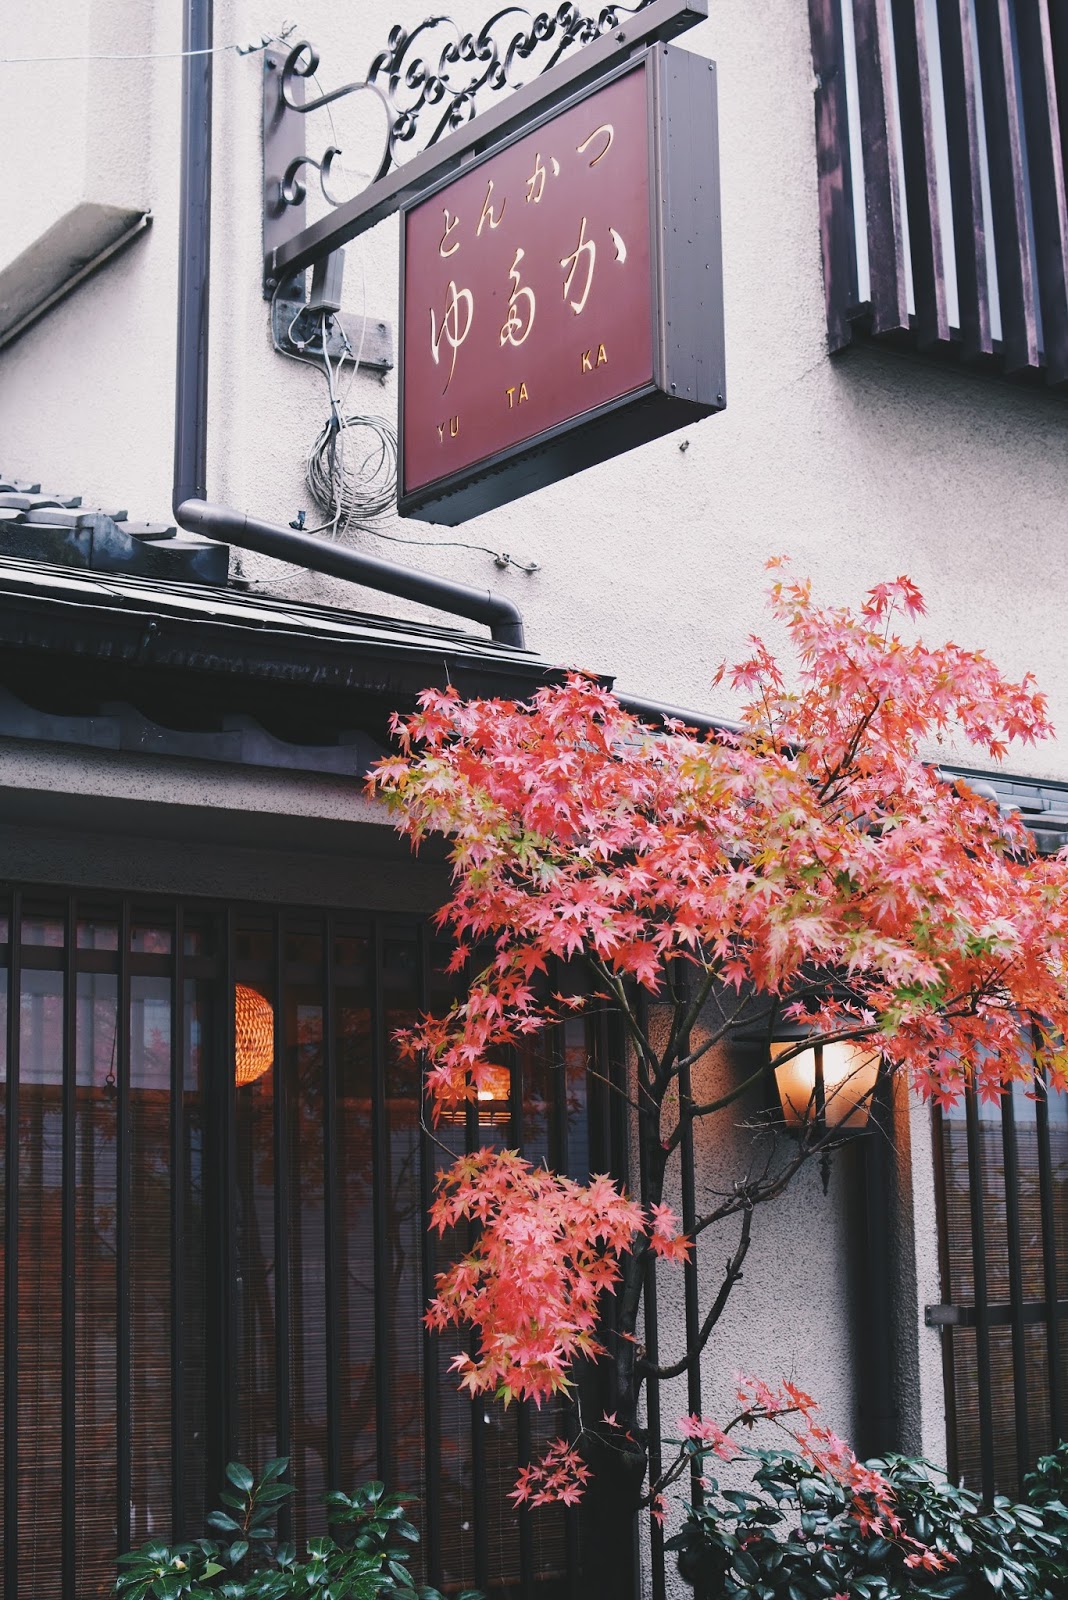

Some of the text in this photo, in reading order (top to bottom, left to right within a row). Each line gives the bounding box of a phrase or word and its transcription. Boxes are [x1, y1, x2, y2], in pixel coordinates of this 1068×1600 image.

[438, 123, 615, 258] とんかつ
[436, 343, 609, 443] YU TA KA
